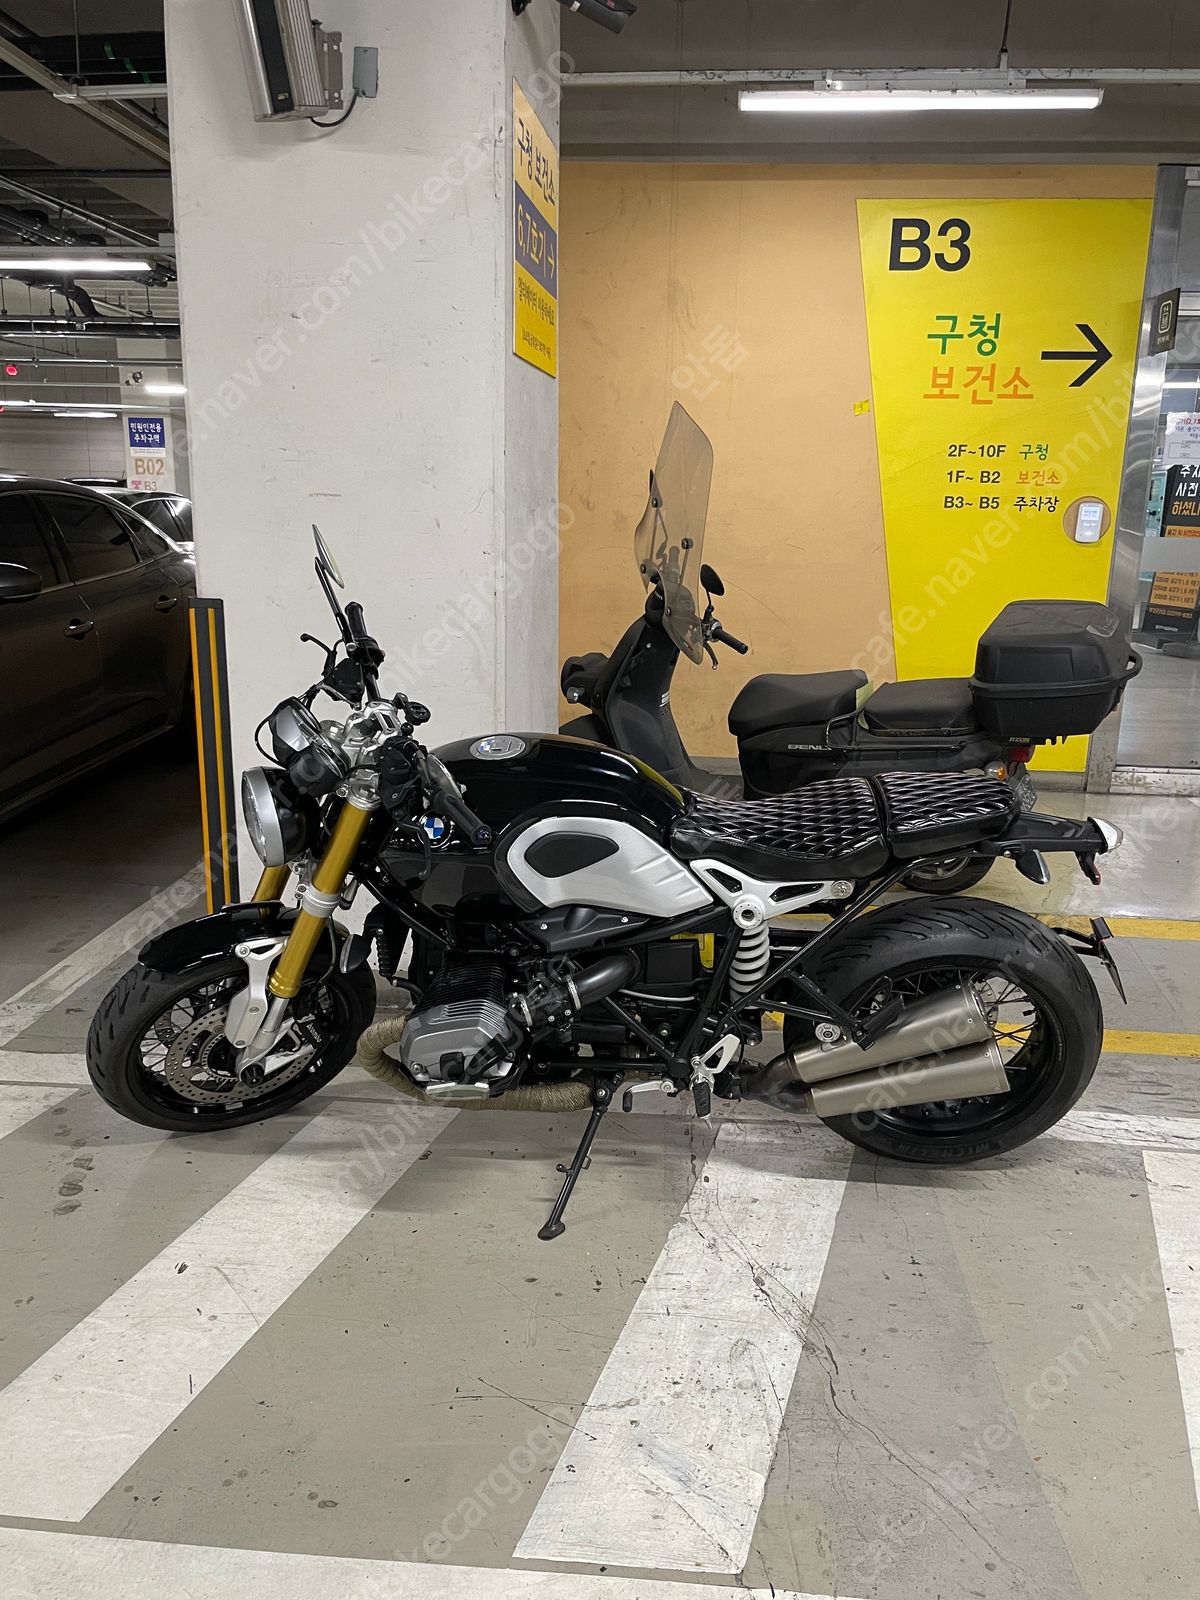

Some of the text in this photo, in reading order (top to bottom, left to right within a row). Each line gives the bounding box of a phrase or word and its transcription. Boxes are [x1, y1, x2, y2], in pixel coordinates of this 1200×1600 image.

[517, 117, 555, 206] 구청 보건소
[517, 203, 547, 278] 6,7호기
[888, 218, 971, 272] B3
[927, 313, 1001, 357] 구청
[923, 363, 1034, 405] 보건소
[130, 422, 161, 433] 민원인전용
[134, 434, 160, 444] 주차구역
[948, 443, 1049, 460] 2F~10F 구청
[134, 459, 164, 476] B02
[144, 481, 157, 491] B3
[980, 471, 1000, 483] B2
[1016, 469, 1060, 486] 보건소
[979, 496, 1000, 509] B5
[1013, 496, 1060, 512] 주차장
